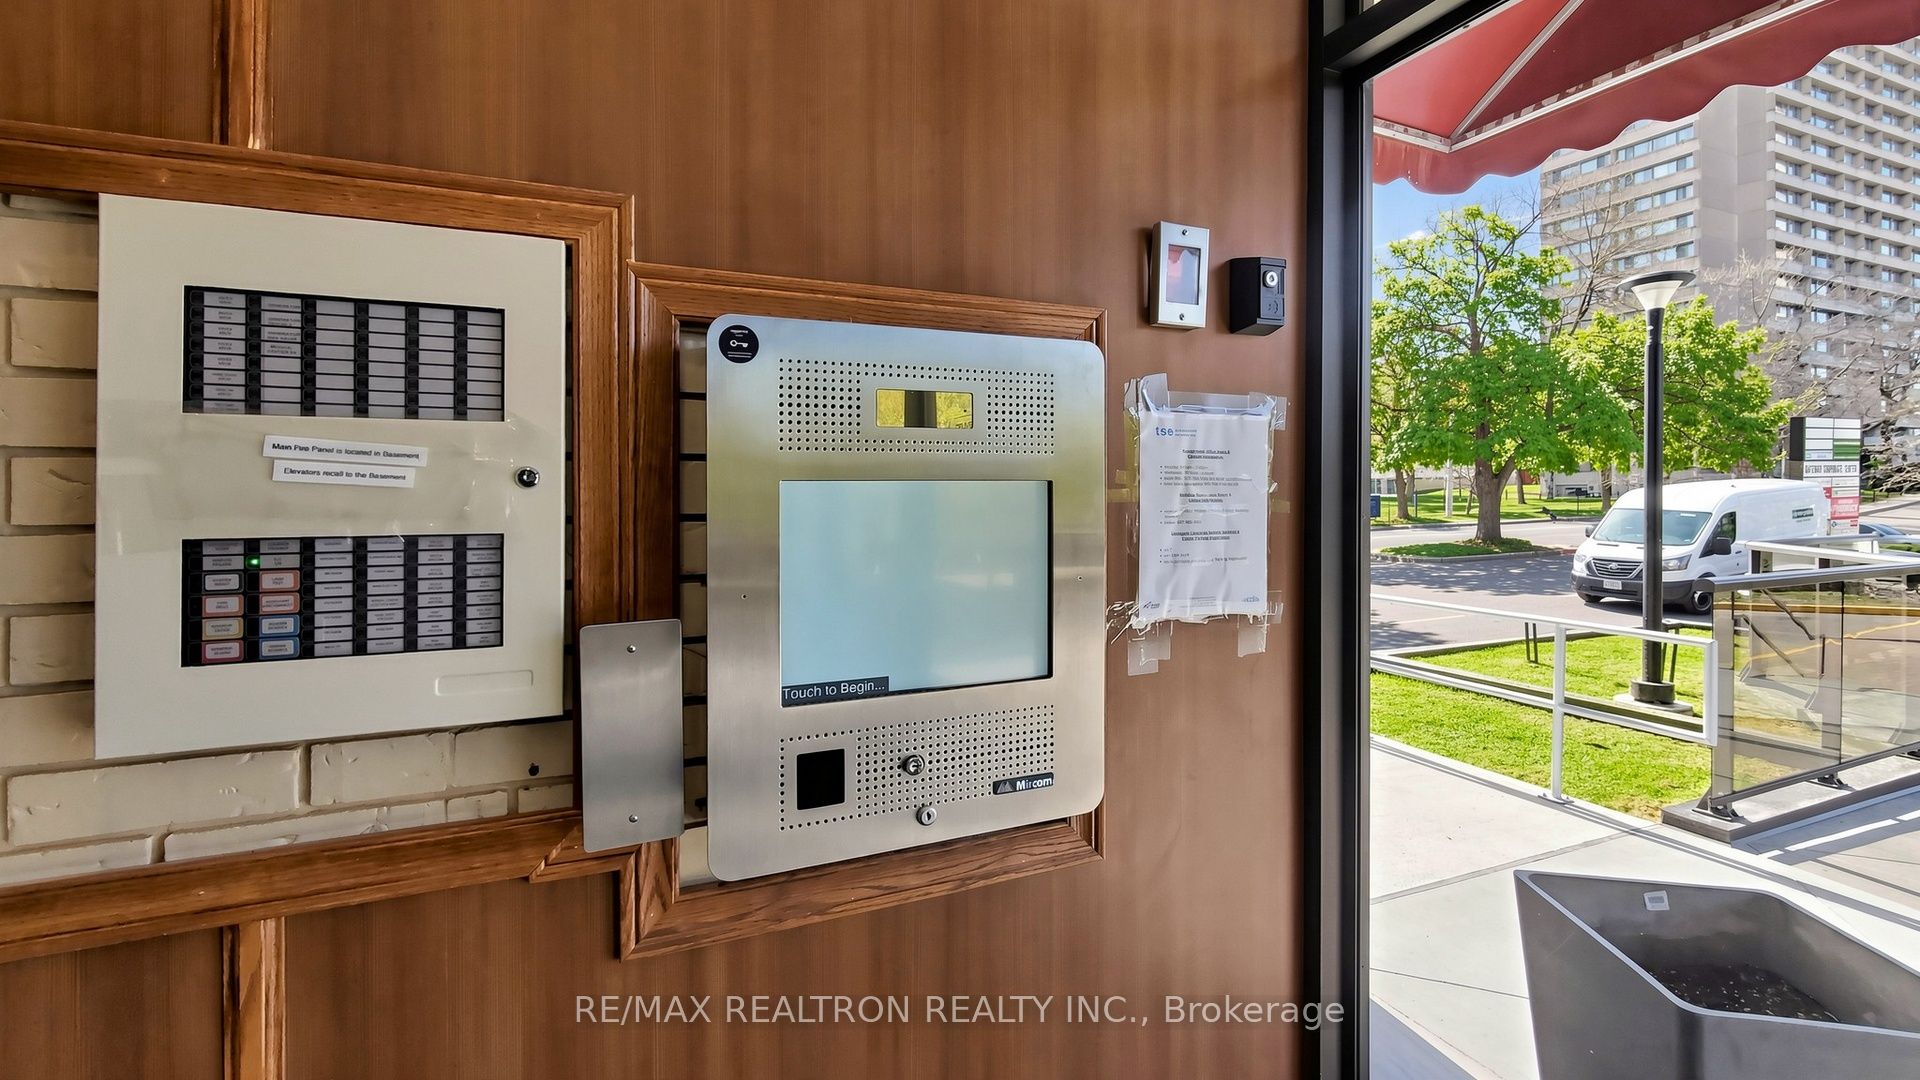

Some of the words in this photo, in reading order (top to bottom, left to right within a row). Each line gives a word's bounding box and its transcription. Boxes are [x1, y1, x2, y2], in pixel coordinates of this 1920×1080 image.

[272, 443, 292, 451] Main
[311, 446, 335, 454] Panel
[344, 449, 372, 457] located
[382, 451, 420, 460] Basement
[283, 467, 321, 476] Elevators
[368, 472, 406, 480] Basement
[782, 685, 822, 699] Touch
[825, 685, 837, 696] to
[840, 681, 885, 695] Begin...
[1016, 777, 1052, 791] Mircom
